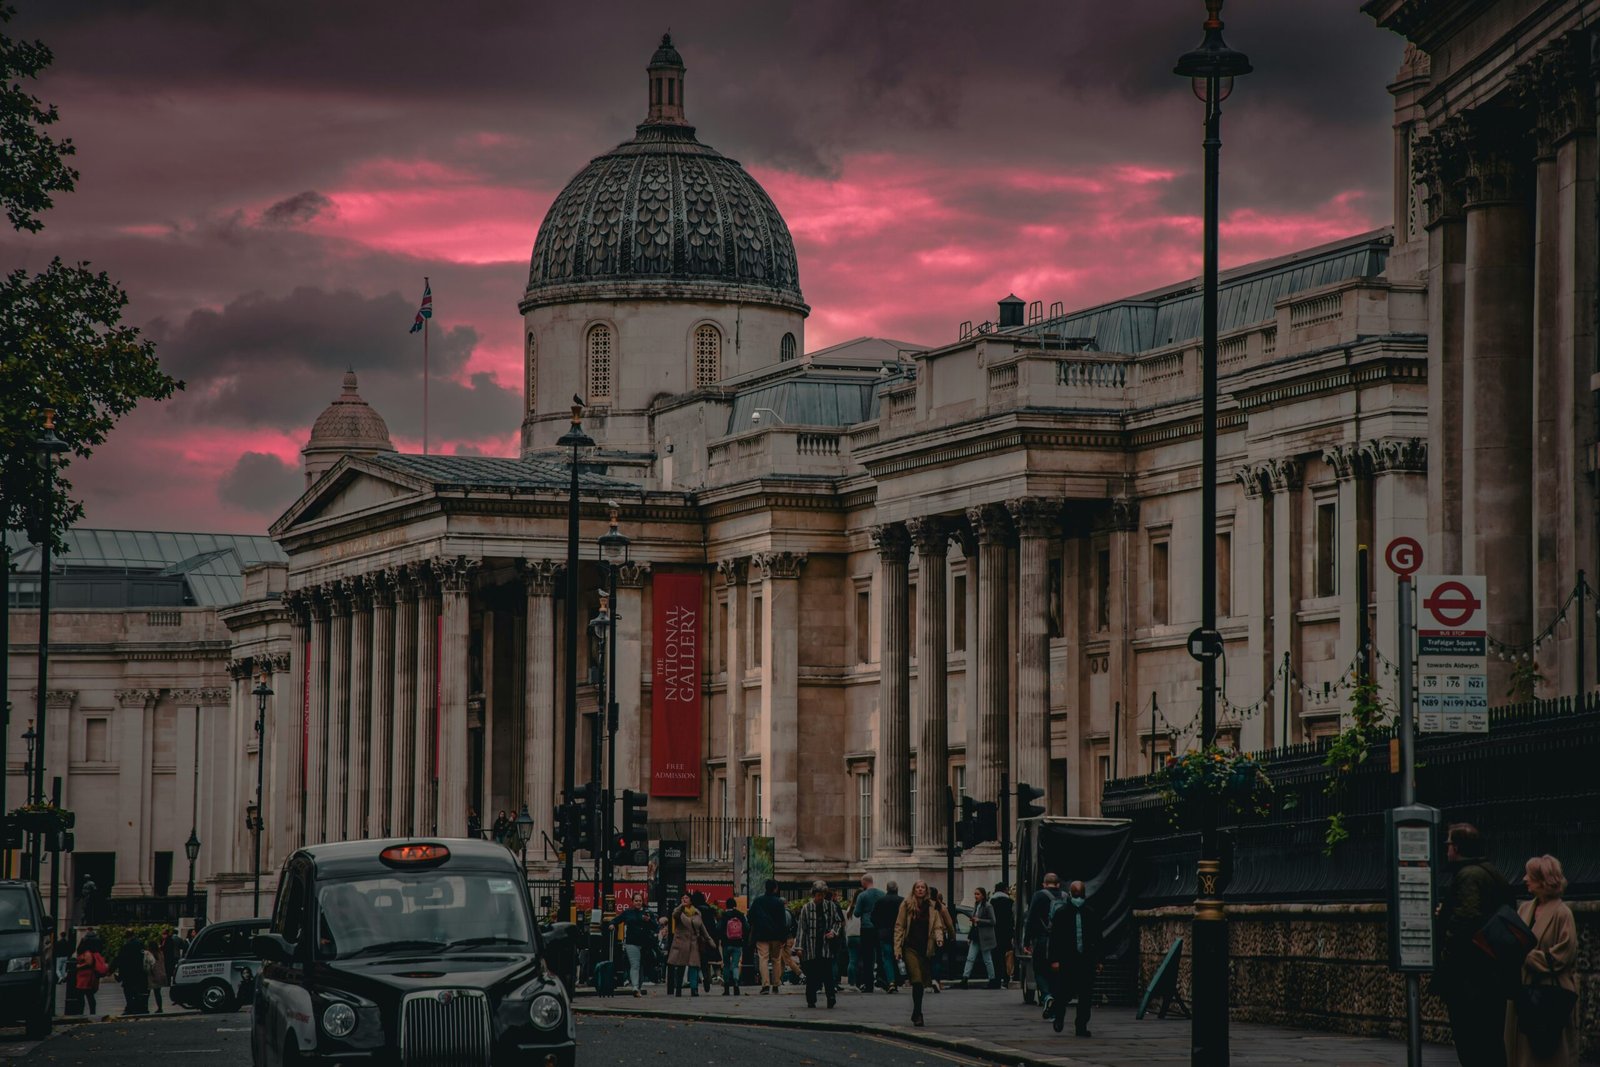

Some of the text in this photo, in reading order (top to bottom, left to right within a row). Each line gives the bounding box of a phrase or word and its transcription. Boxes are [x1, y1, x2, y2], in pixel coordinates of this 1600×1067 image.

[1391, 543, 1414, 569] G
[665, 605, 679, 701] NATIONAL
[680, 606, 696, 702] GALLERY
[656, 657, 664, 676] THE
[1447, 680, 1460, 688] 176
[397, 846, 437, 861] TAXI
